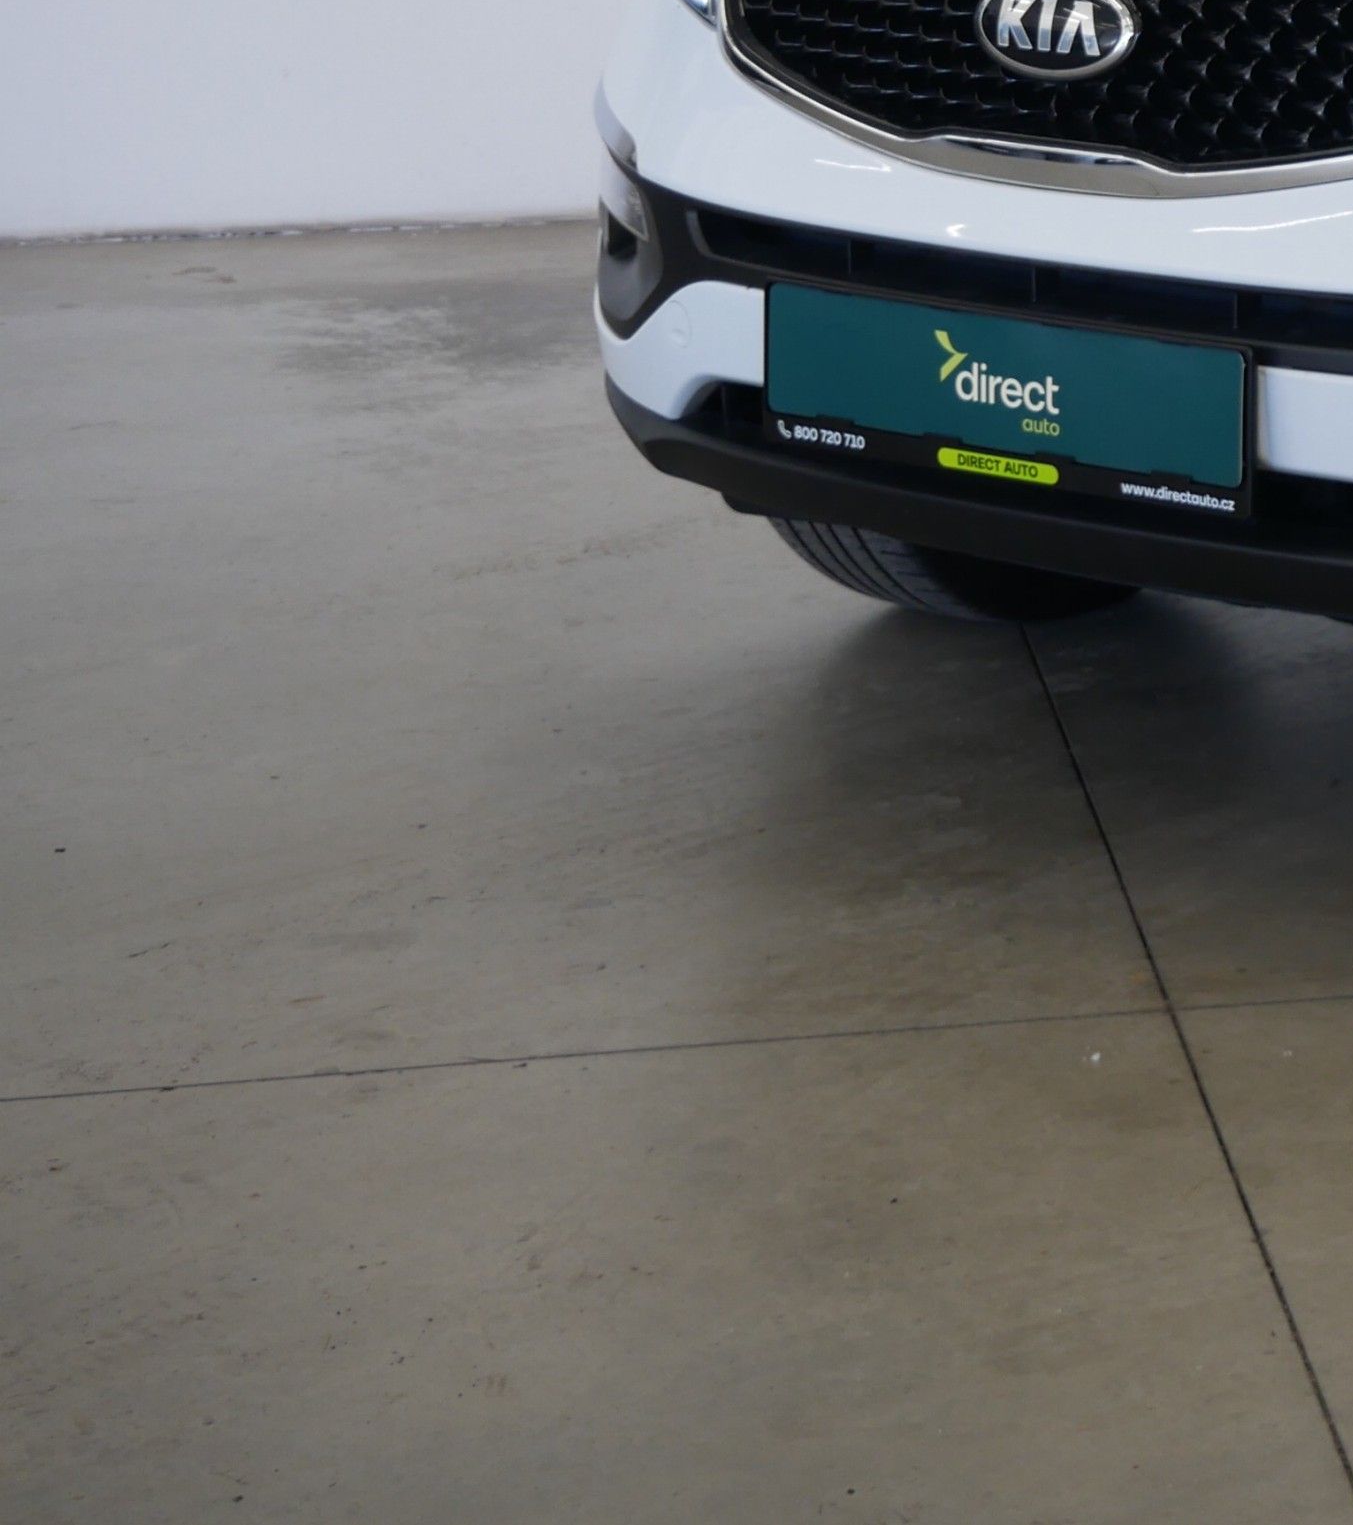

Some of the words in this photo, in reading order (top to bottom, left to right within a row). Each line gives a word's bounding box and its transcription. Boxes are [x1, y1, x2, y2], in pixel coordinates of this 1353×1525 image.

[955, 361, 1060, 415] direct
[794, 425, 818, 440] 800
[820, 429, 842, 444] 720
[844, 433, 866, 449] 710
[1022, 418, 1060, 436] auto
[957, 453, 1001, 471] DIRECT
[1003, 461, 1039, 478] AUTO
[1120, 482, 1236, 511] www.directauto.cz
